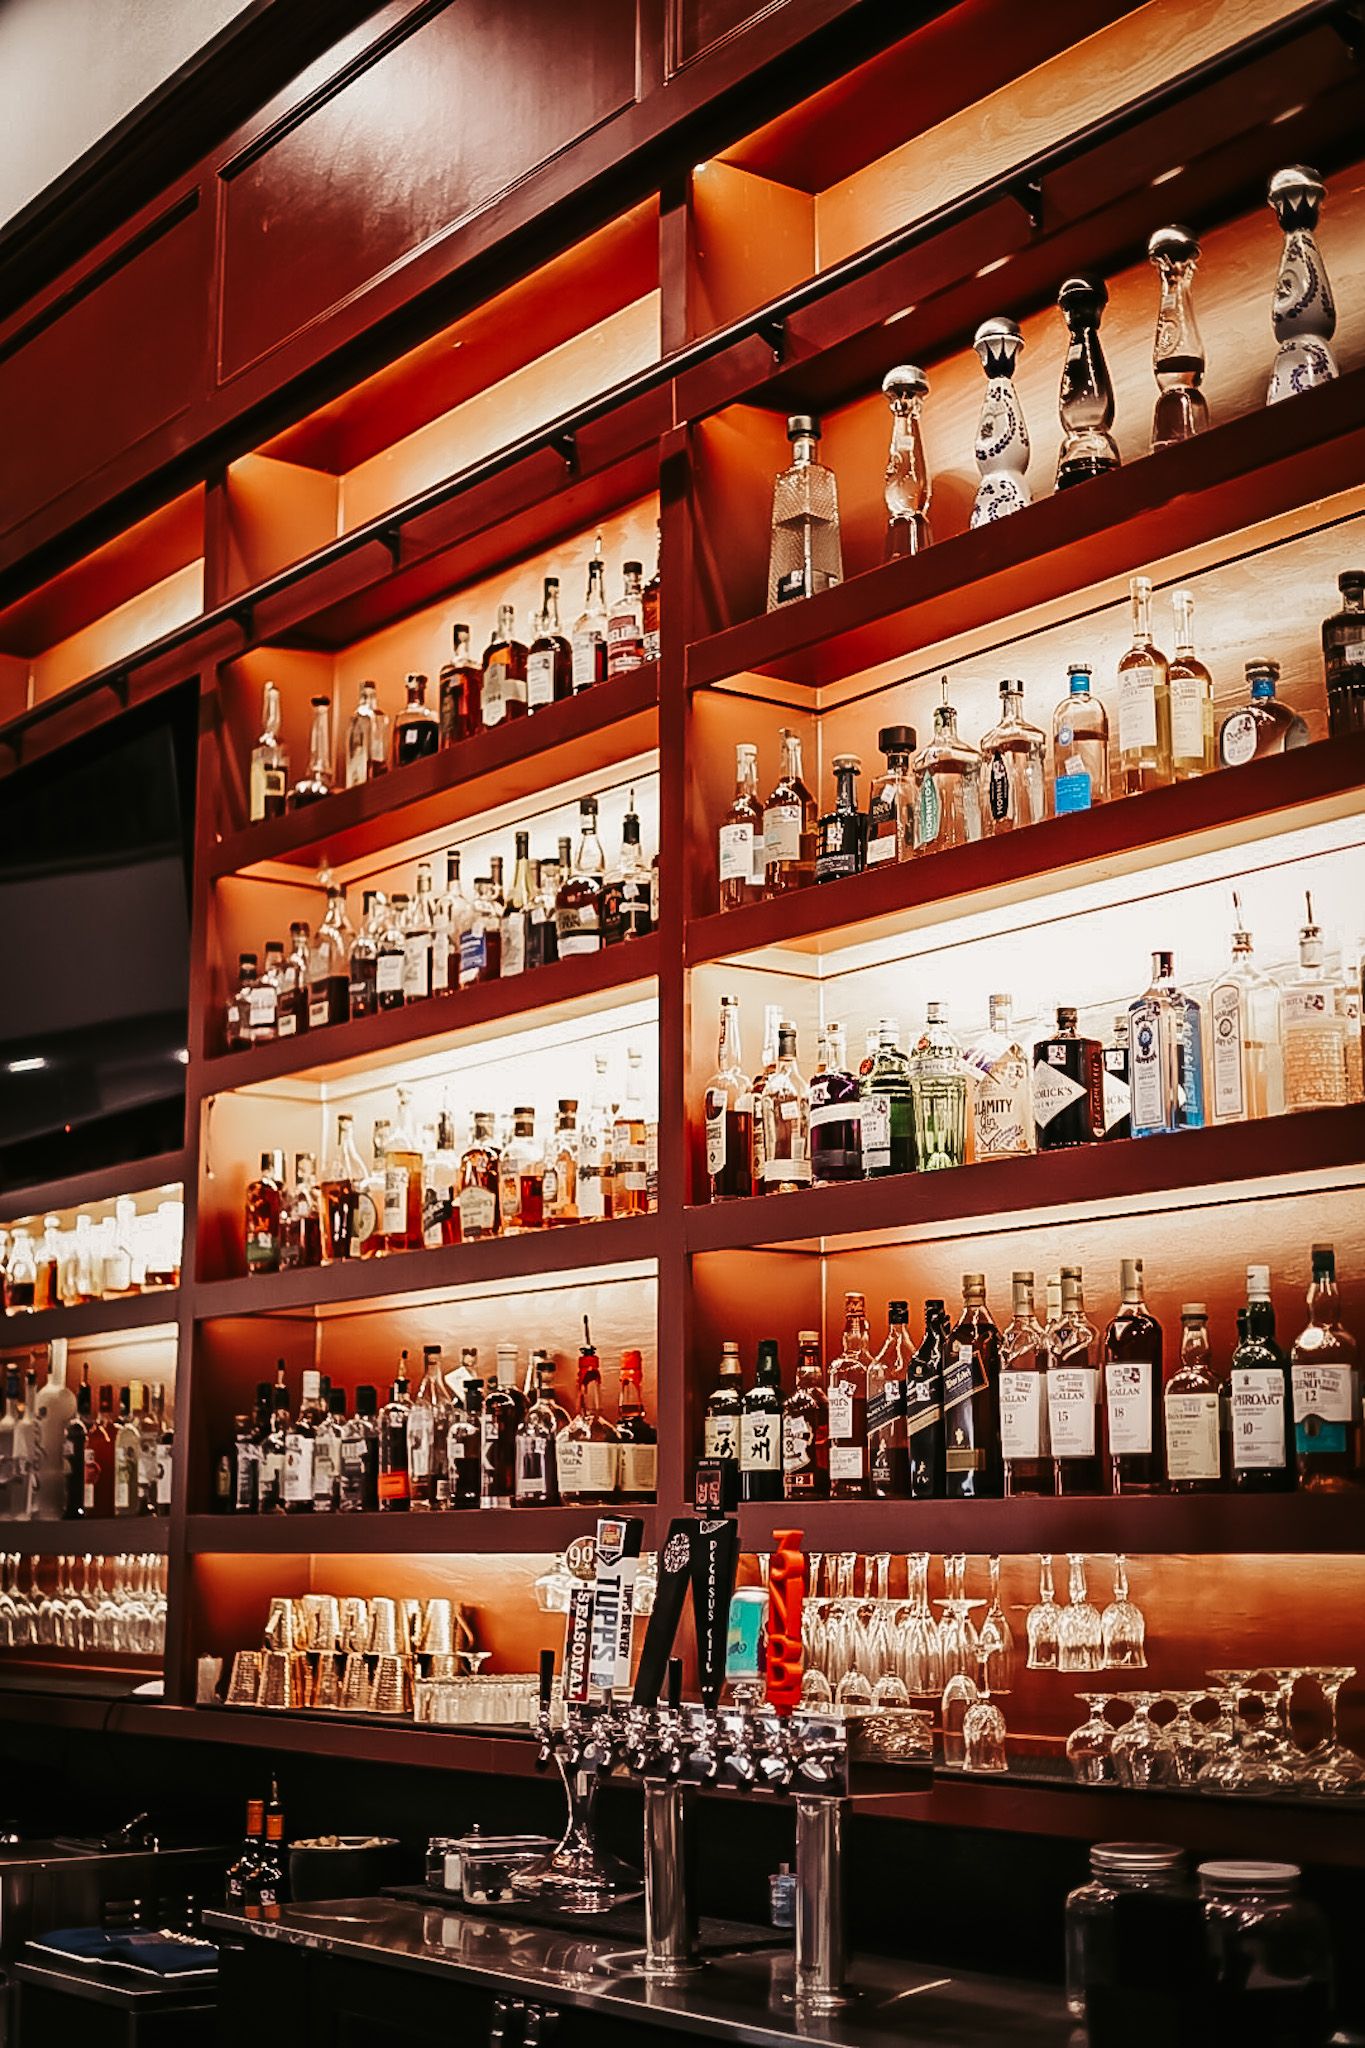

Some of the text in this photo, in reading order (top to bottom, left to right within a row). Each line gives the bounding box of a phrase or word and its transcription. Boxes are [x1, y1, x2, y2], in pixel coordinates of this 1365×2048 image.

[924, 779, 933, 838] HORNITOS
[975, 1099, 1013, 1116] LAMITY
[1305, 1390, 1317, 1403] 12
[1004, 1413, 1013, 1425] 12
[1057, 1410, 1069, 1422] 15
[1114, 1407, 1125, 1418] 18
[1243, 1422, 1253, 1435] 10
[795, 1475, 804, 1484] 12
[707, 1540, 718, 1621] PEGASUS
[592, 1575, 621, 1662] TUPPS
[619, 1584, 634, 1659] TUPPS BREWERY
[569, 1591, 590, 1699] SEASONAL
